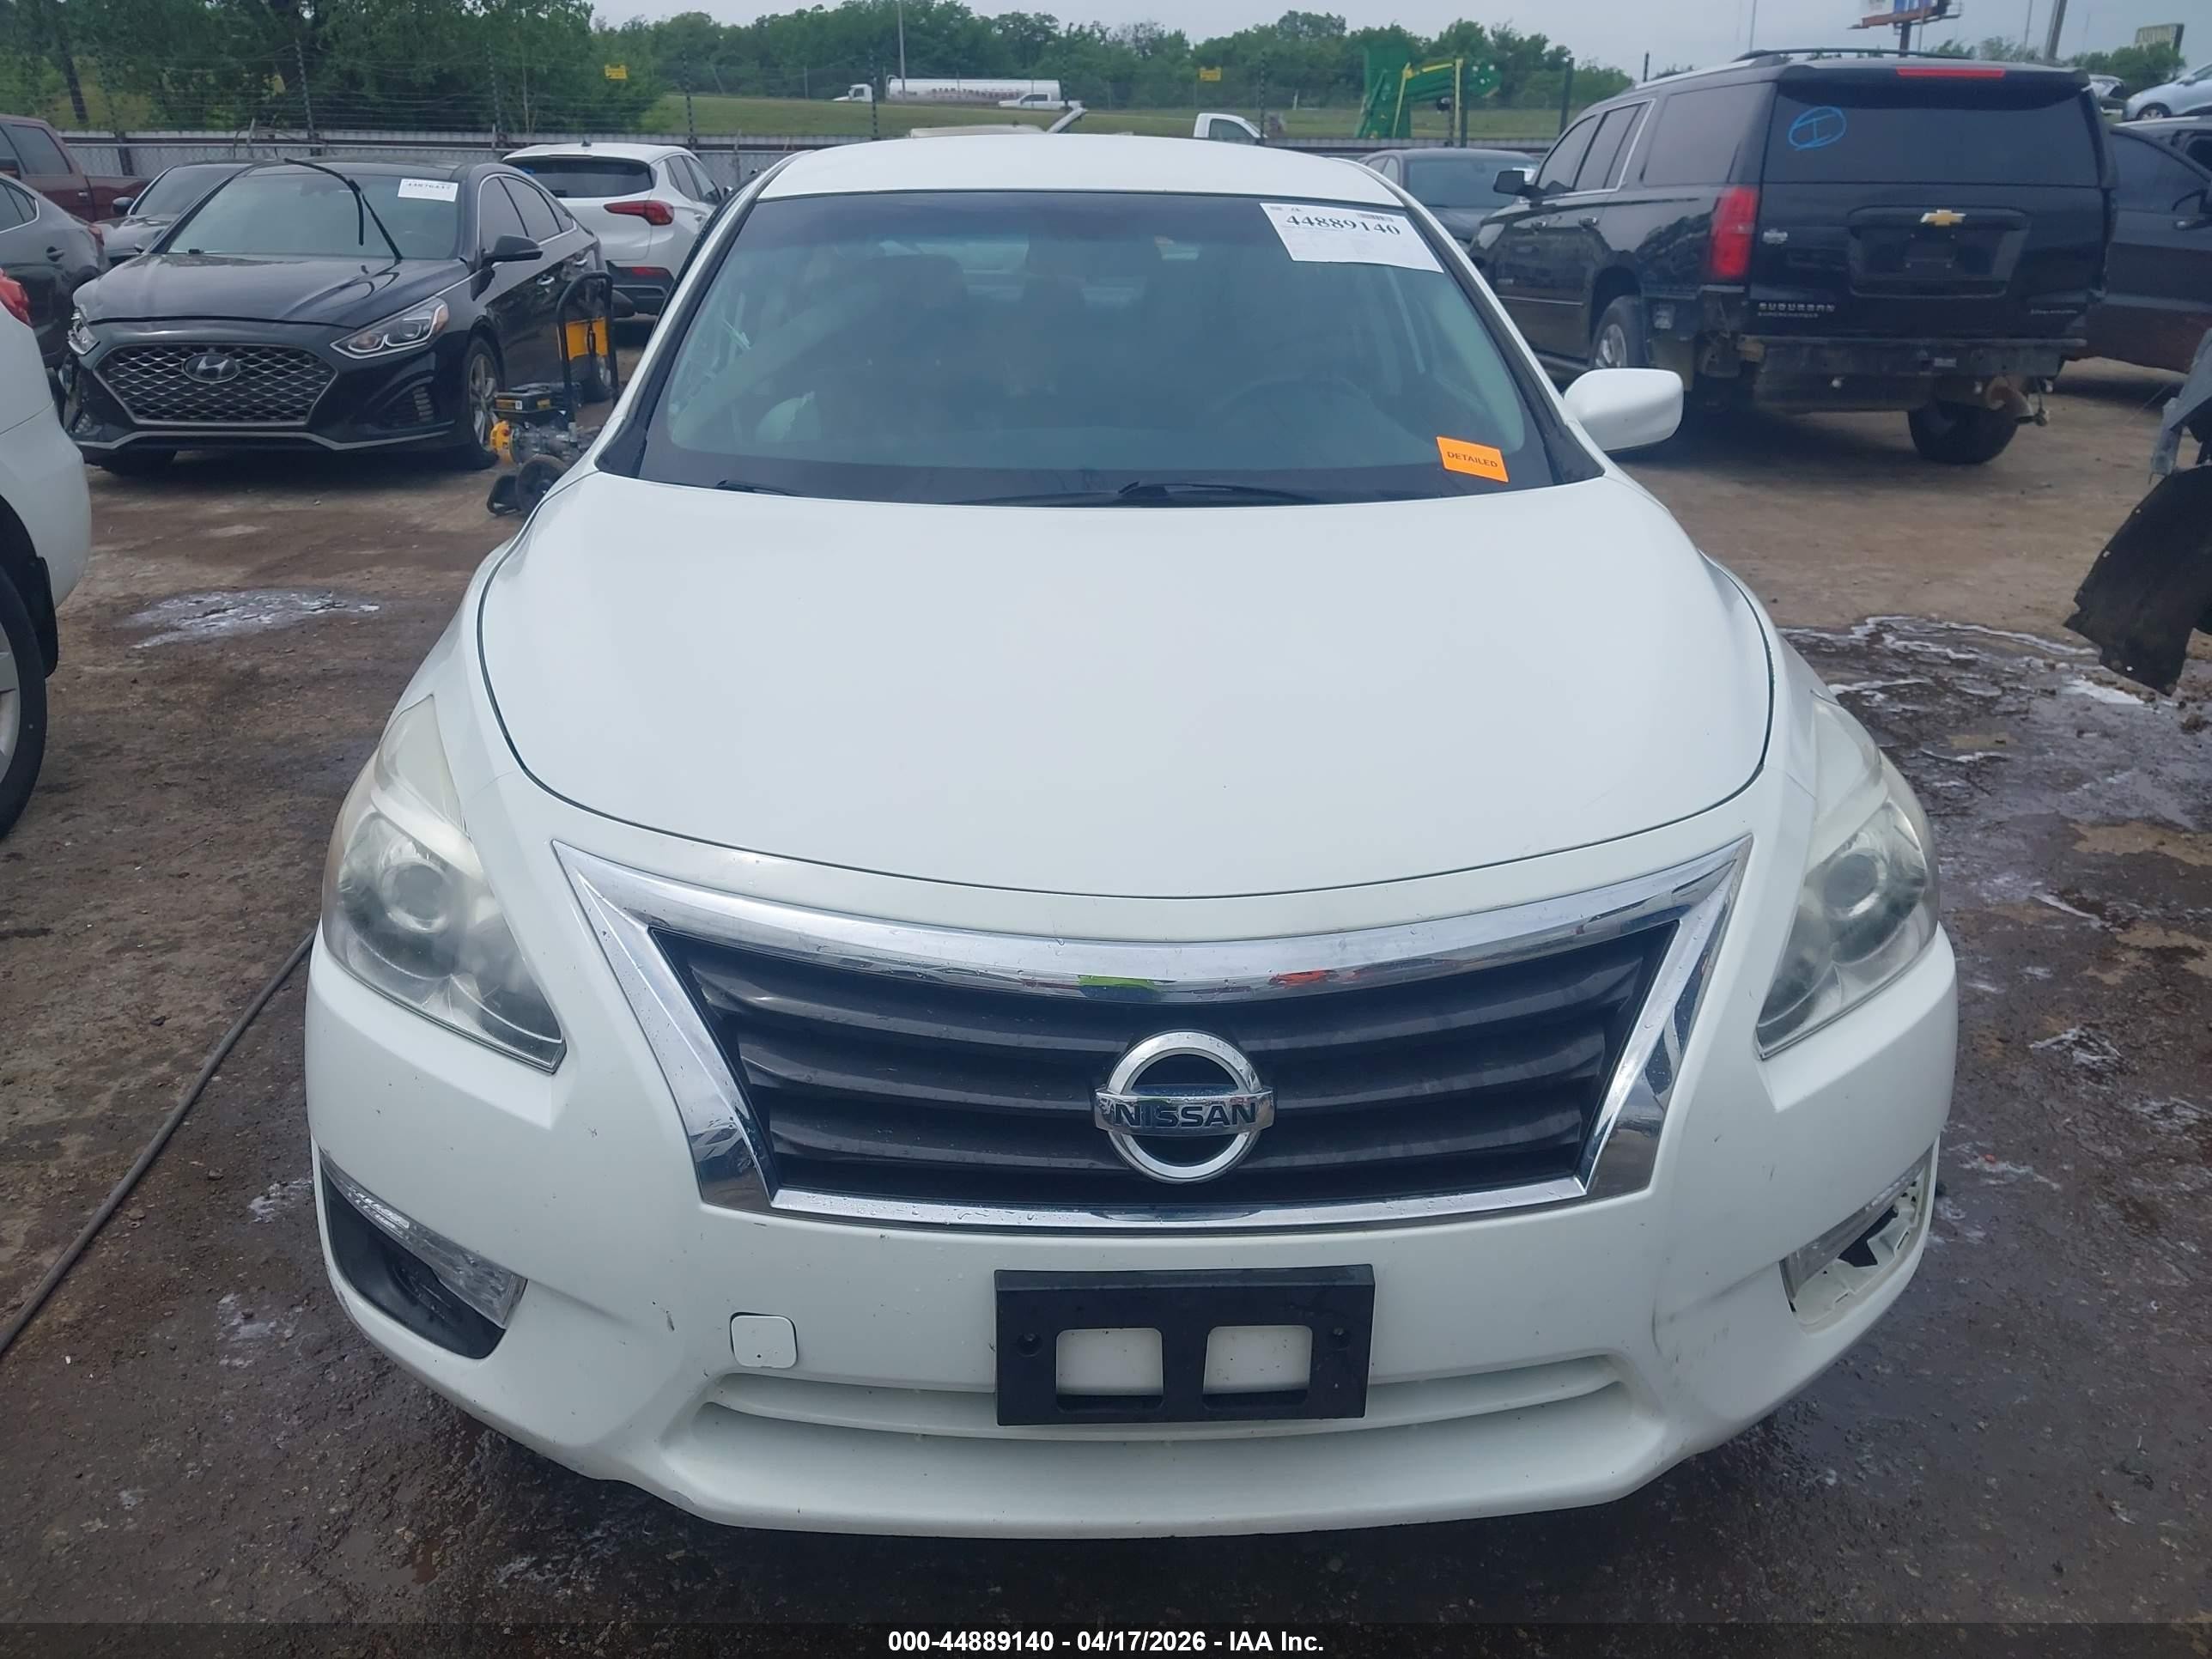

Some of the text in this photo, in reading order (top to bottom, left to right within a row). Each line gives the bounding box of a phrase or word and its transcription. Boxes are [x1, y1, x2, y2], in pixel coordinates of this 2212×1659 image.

[1285, 214, 1401, 236] 44889140
[1758, 301, 1836, 313] SUBURBAN
[1446, 451, 1498, 468] DETAILED
[1114, 1101, 1256, 1127] NISSAN
